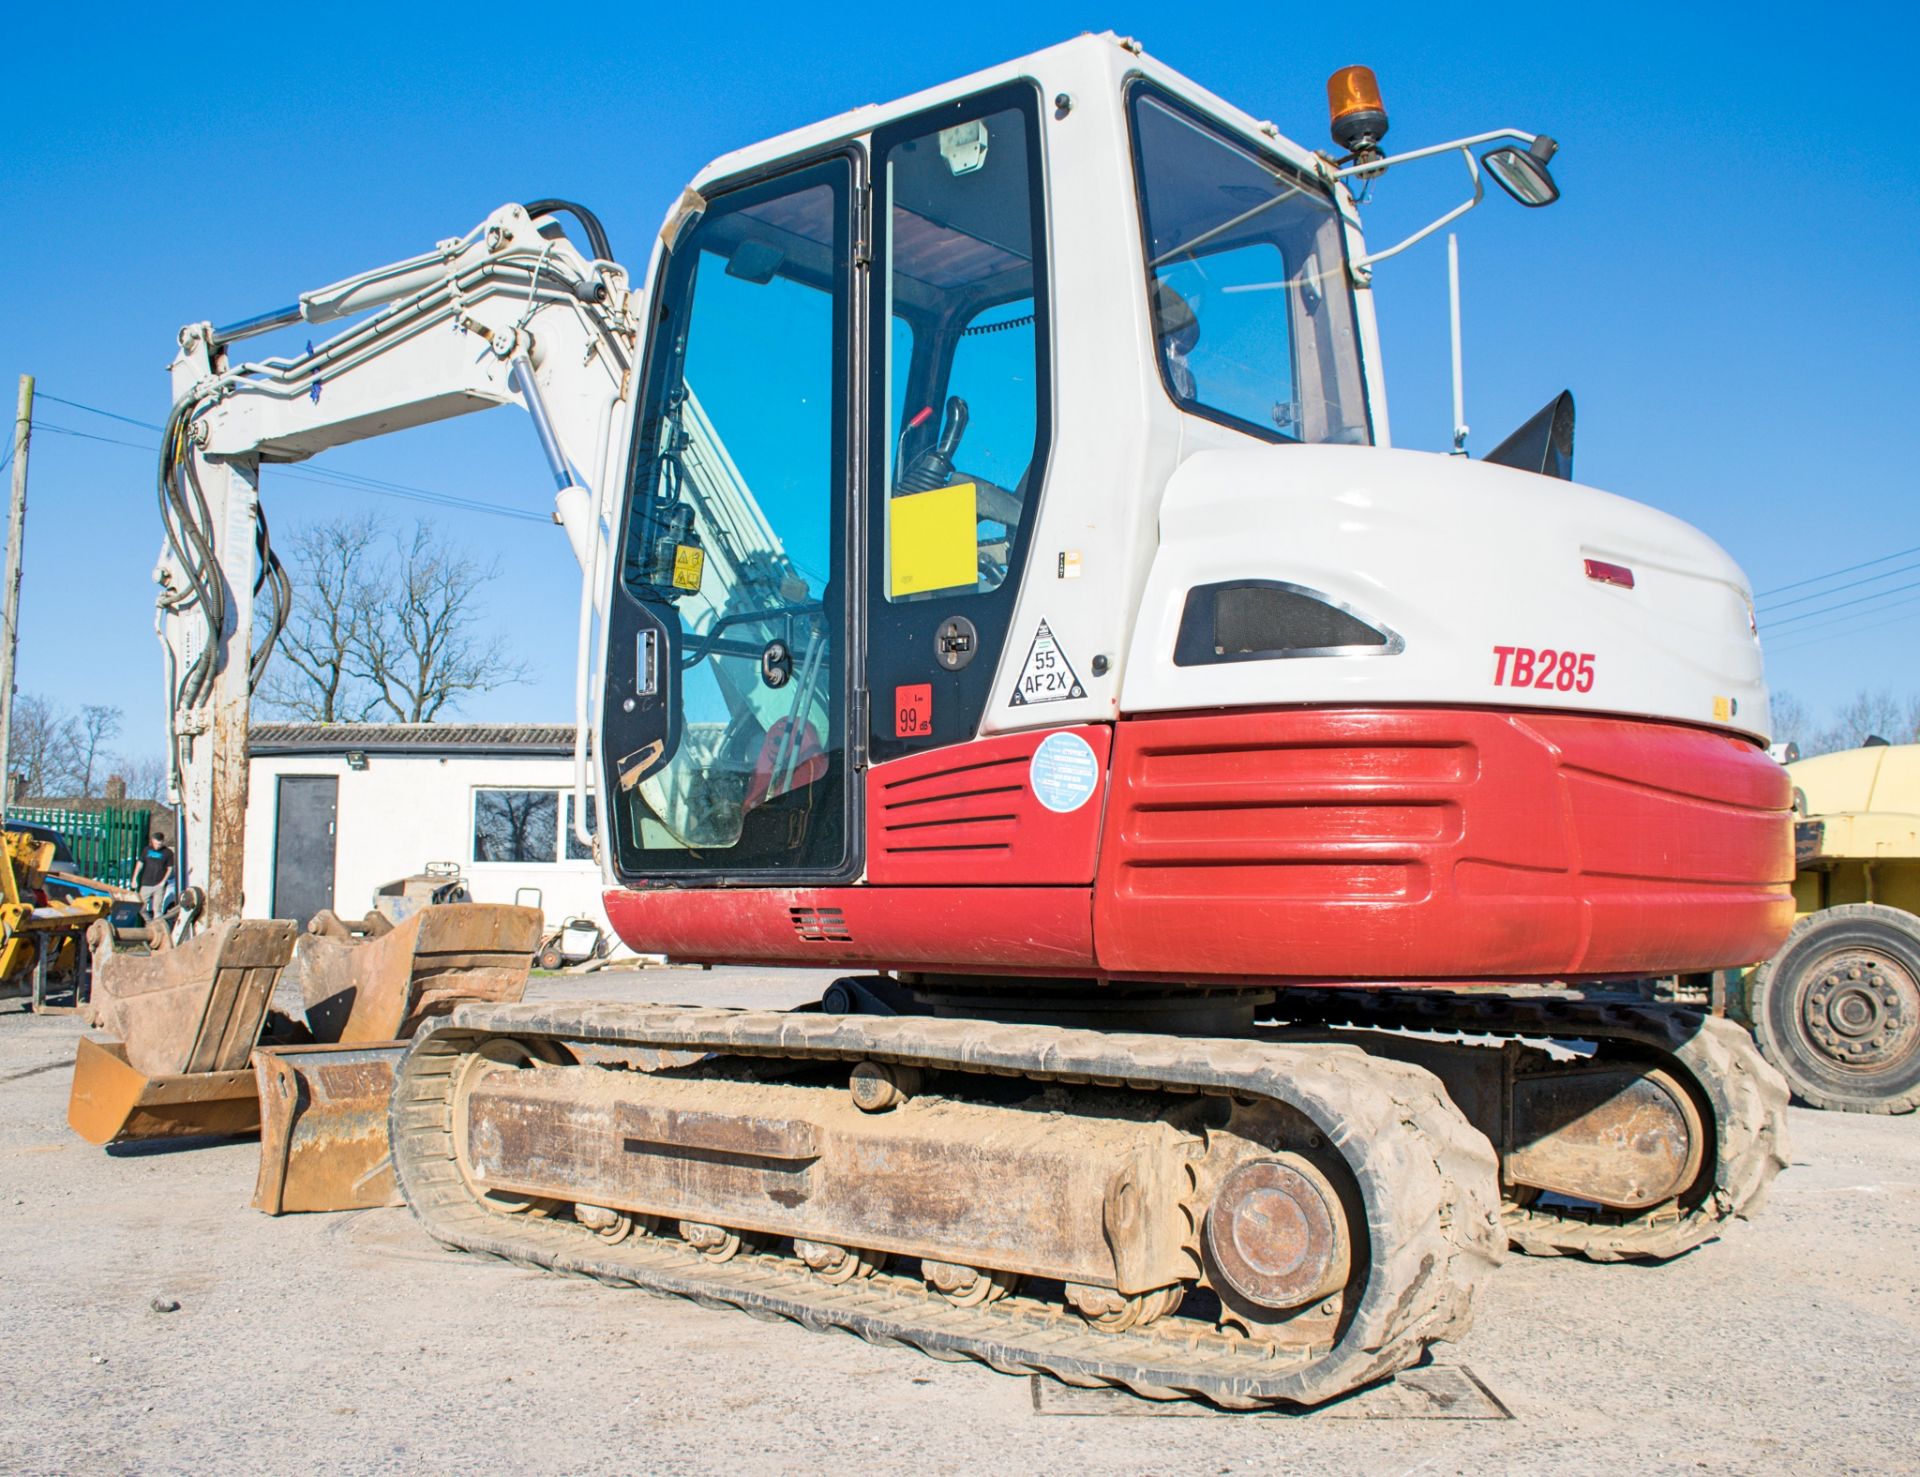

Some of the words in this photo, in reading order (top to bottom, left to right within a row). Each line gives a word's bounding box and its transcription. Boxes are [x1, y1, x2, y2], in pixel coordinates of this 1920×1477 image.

[1035, 651, 1055, 670] 55
[1493, 645, 1596, 694] TB285
[1025, 671, 1067, 693] AF2X
[900, 708, 917, 732] 99
